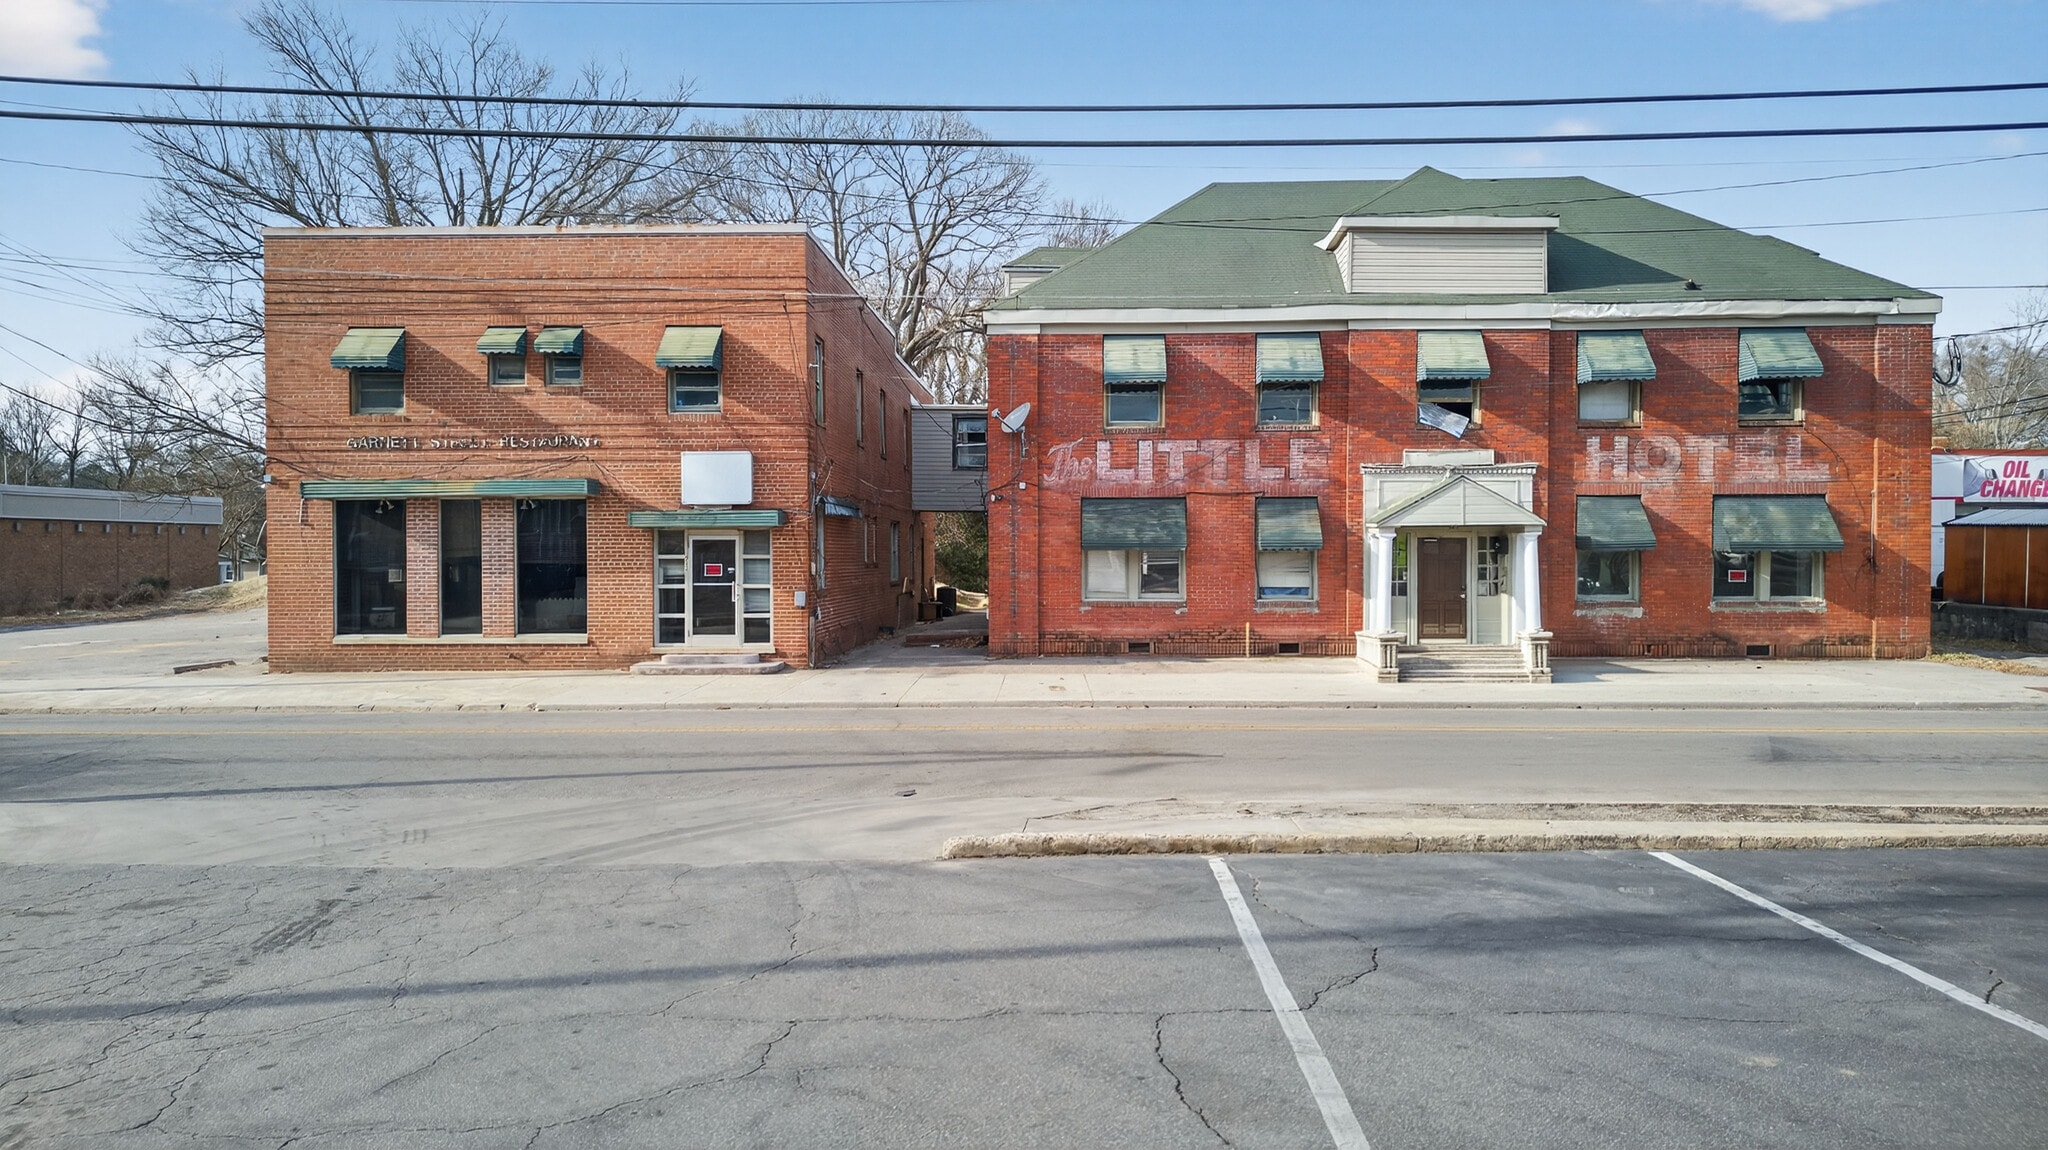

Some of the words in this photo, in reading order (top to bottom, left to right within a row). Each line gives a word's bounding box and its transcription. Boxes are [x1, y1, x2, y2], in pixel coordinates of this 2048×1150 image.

[1043, 436, 1093, 482] The
[1096, 437, 1331, 482] LITTLE
[1585, 434, 1831, 482] HOTEL
[2003, 460, 2031, 479] OIL
